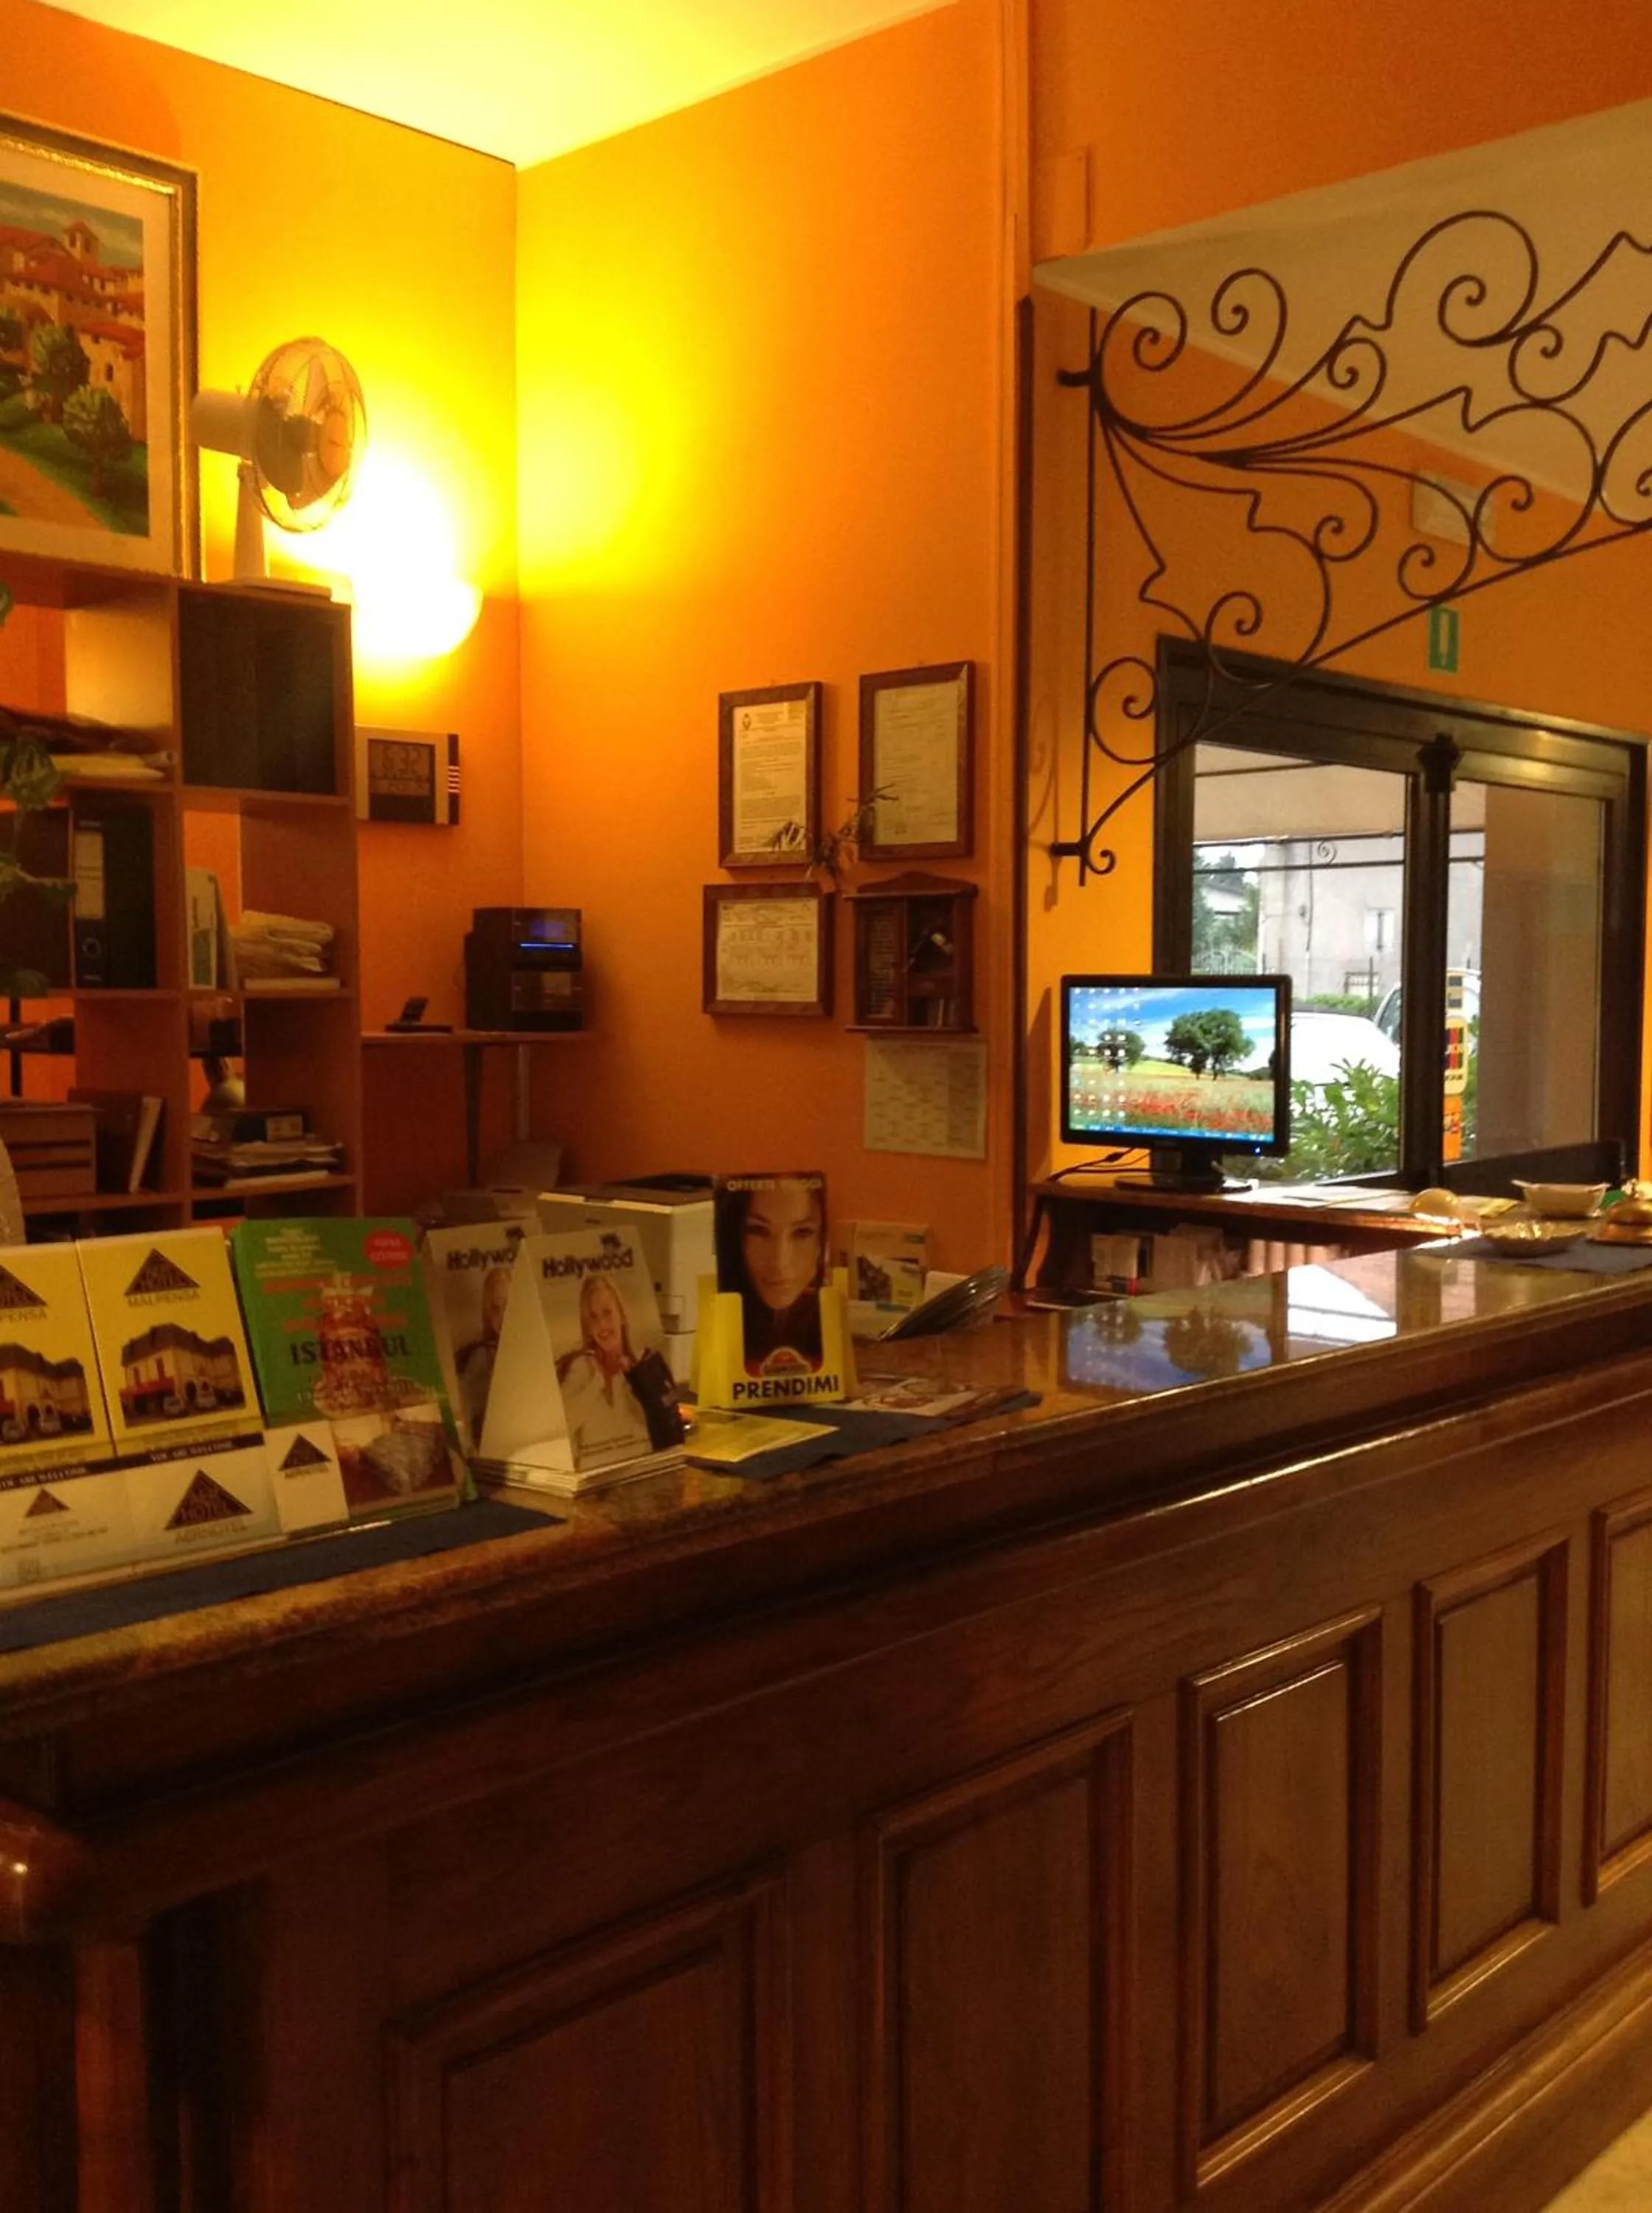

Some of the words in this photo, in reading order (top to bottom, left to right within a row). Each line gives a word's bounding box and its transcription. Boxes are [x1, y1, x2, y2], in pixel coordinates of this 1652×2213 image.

[542, 1247, 634, 1279] Hollywood
[290, 1334, 412, 1365] ISTANBUL
[732, 1374, 840, 1401] PRENDIMI
